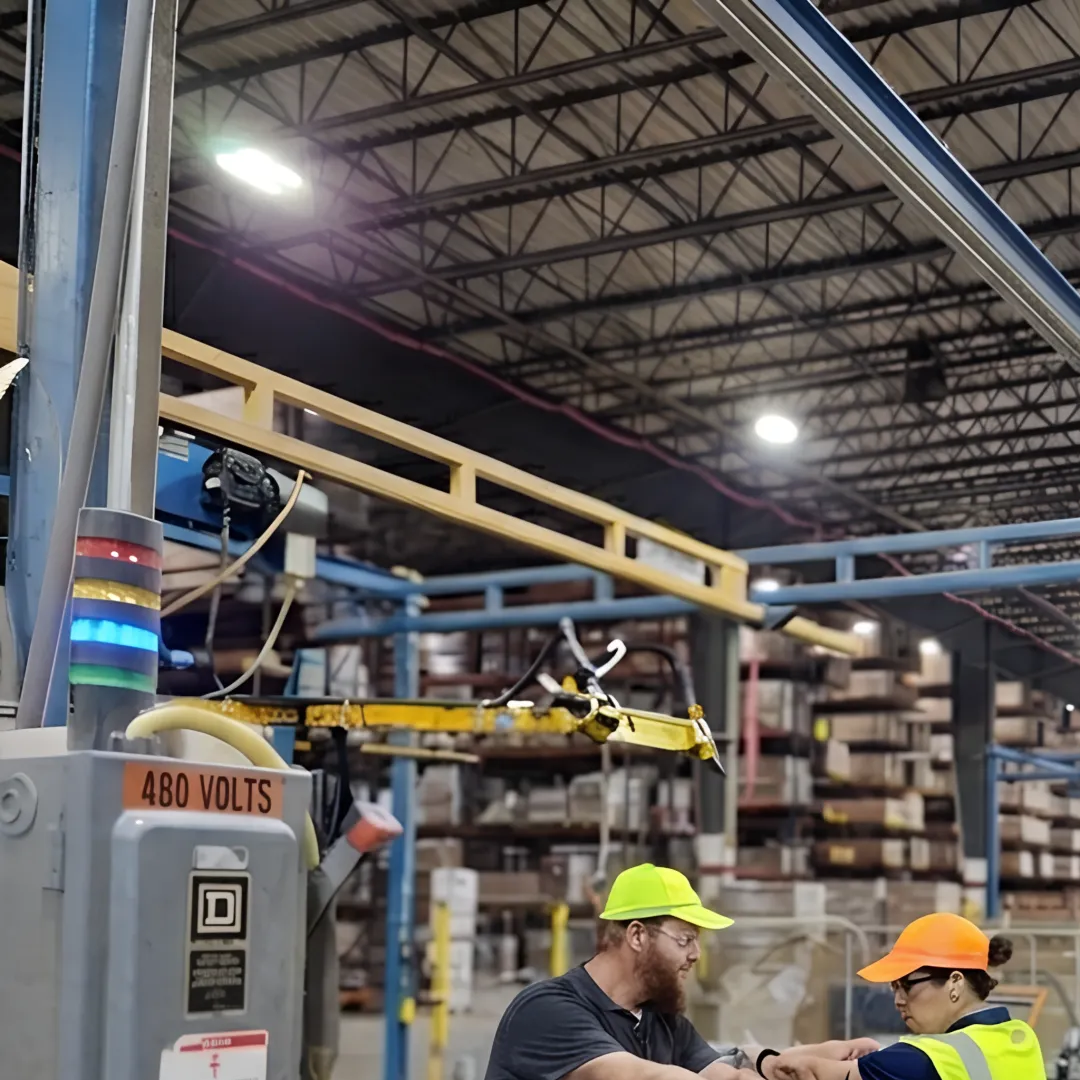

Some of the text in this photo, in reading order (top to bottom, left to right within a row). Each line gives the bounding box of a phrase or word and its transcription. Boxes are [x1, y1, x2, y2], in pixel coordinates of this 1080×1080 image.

[141, 770, 272, 814] 480 VOLTS
[204, 891, 235, 925] D
